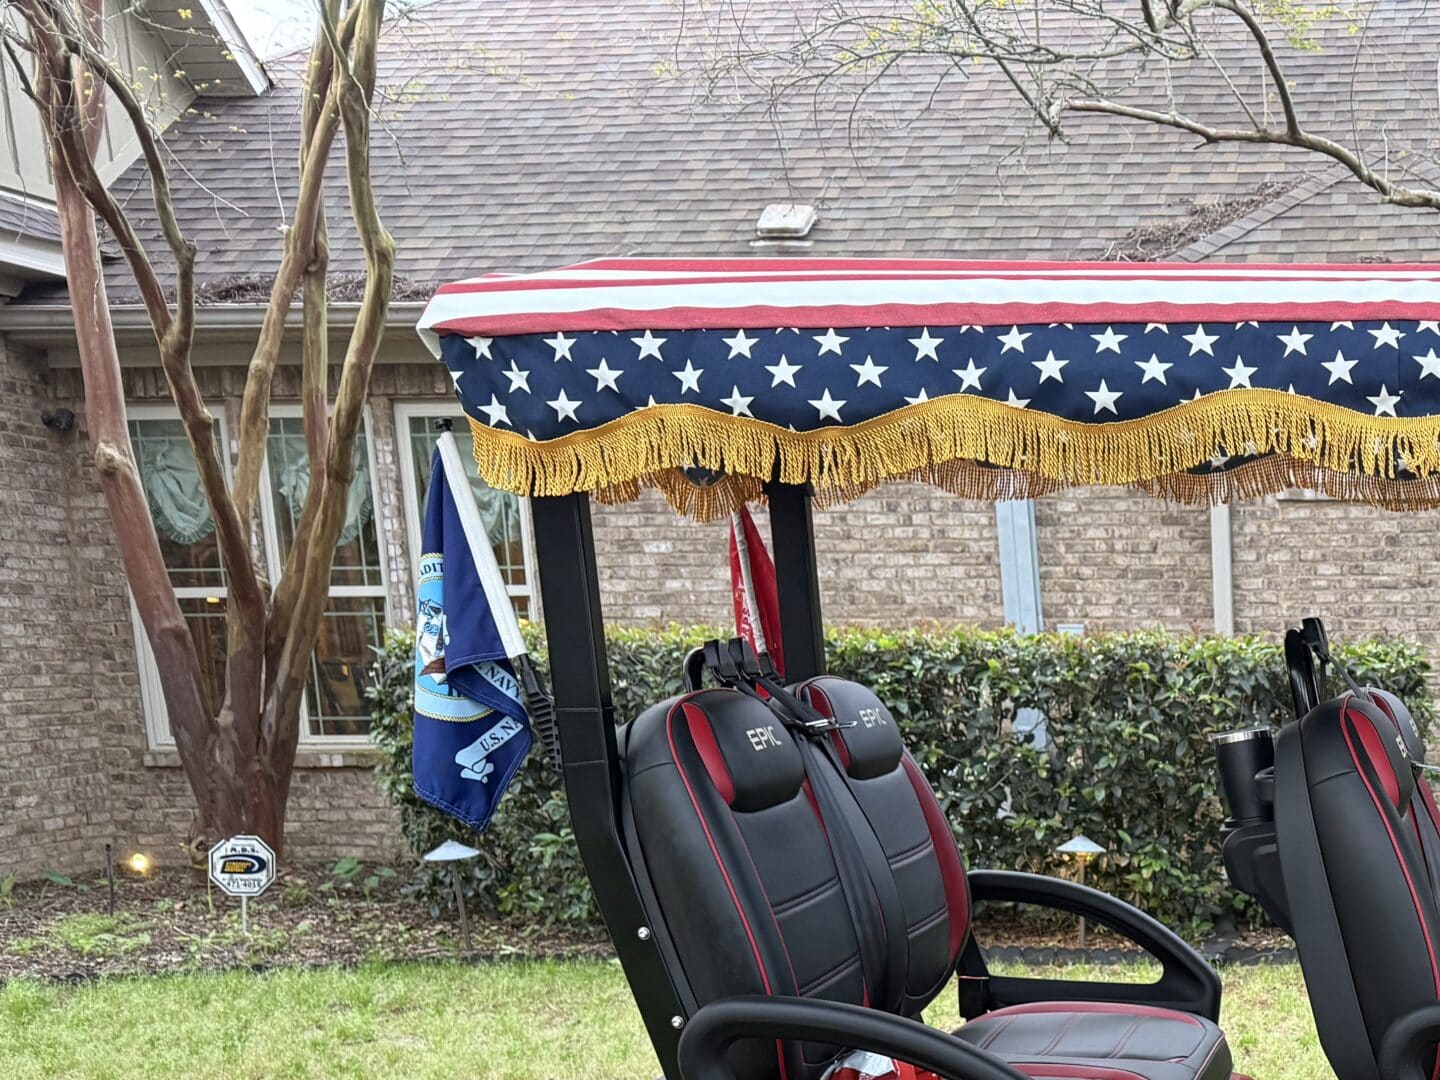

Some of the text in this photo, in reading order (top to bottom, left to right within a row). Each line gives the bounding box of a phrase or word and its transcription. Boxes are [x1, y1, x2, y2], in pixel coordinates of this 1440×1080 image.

[858, 707, 887, 728] EPIC
[480, 732, 504, 752] U.S.
[746, 725, 782, 751] EPIC
